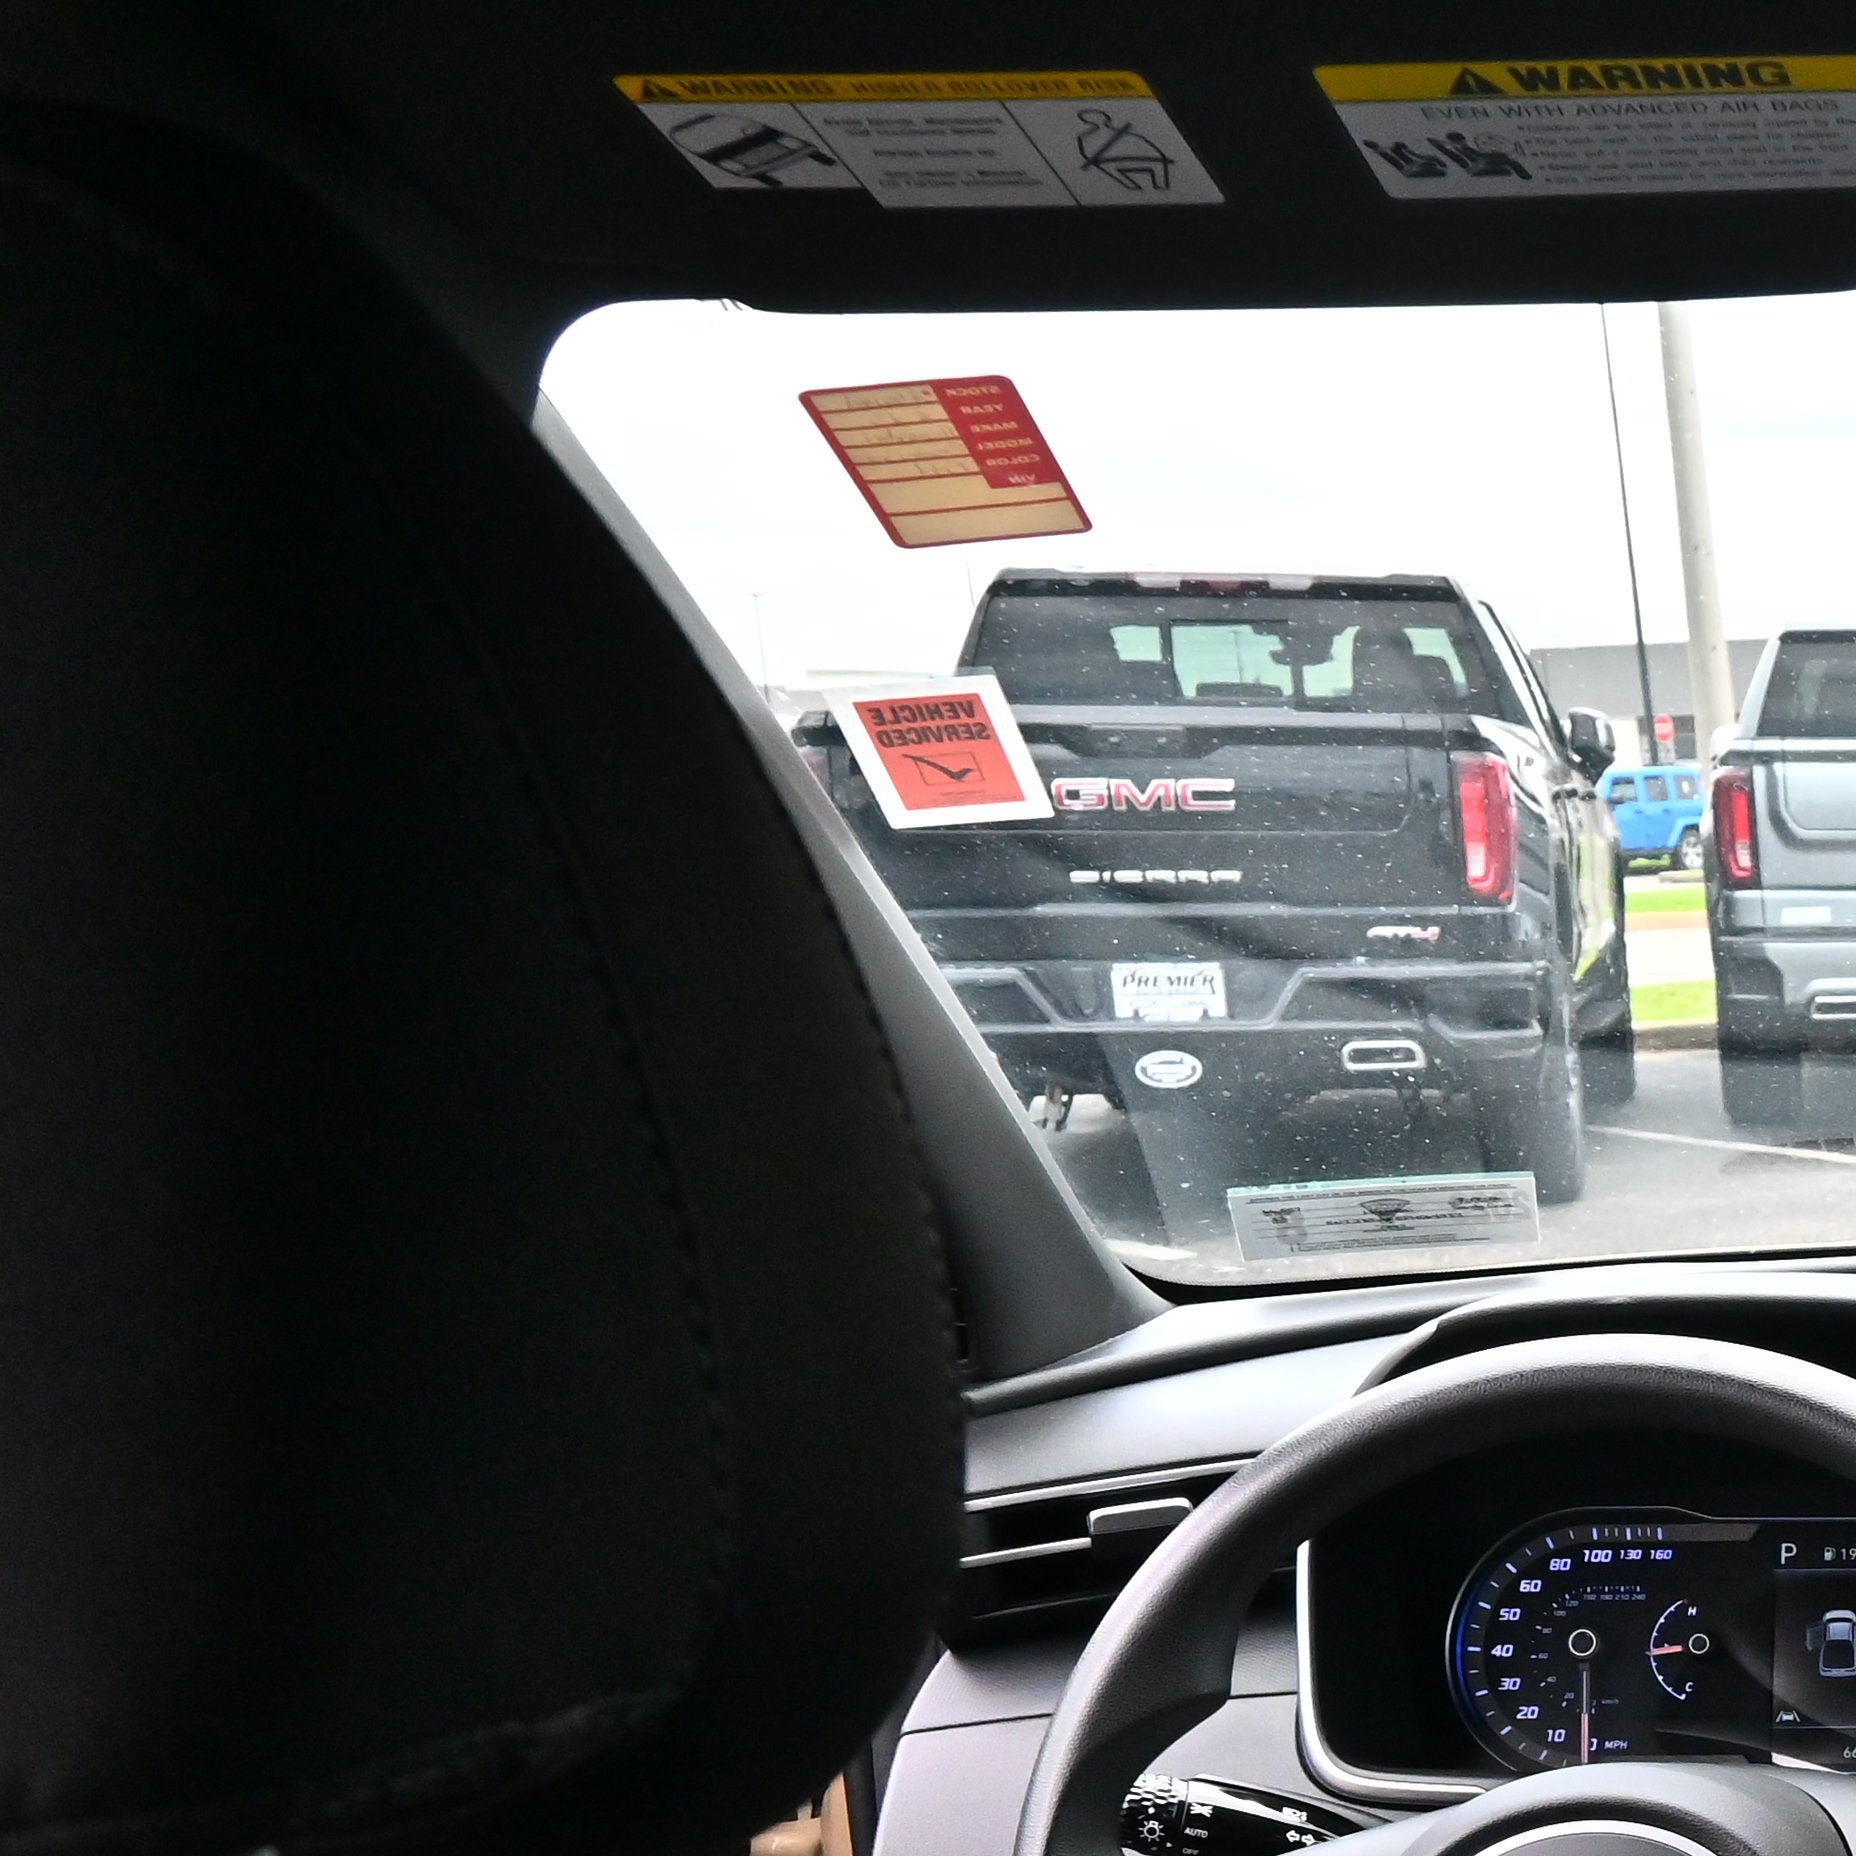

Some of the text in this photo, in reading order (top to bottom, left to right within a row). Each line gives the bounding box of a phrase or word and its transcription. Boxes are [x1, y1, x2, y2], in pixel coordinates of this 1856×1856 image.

[1507, 62, 1791, 91] WARNING
[681, 80, 832, 97] WARNING
[1421, 98, 1839, 120] EVEN WITH ADVANCED AIR BAGS
[1050, 776, 1237, 812] GMC
[1069, 869, 1242, 884] SIERRA
[1121, 968, 1217, 995] PREMIER
[1583, 1549, 1673, 1563] 100 130 160
[1780, 1543, 1798, 1565] P
[1549, 1558, 1572, 1572] 80
[1519, 1579, 1542, 1593] 60
[1499, 1608, 1521, 1621] 50
[1687, 1606, 1698, 1617] H
[1491, 1644, 1514, 1658] 40
[1498, 1677, 1521, 1691] 30
[1685, 1682, 1694, 1692] C
[1516, 1706, 1539, 1719] 20
[1546, 1729, 1566, 1742] 10
[1604, 1741, 1628, 1751] MPH
[1184, 1826, 1209, 1839] AUTO
[1182, 1846, 1199, 1856] OFF
